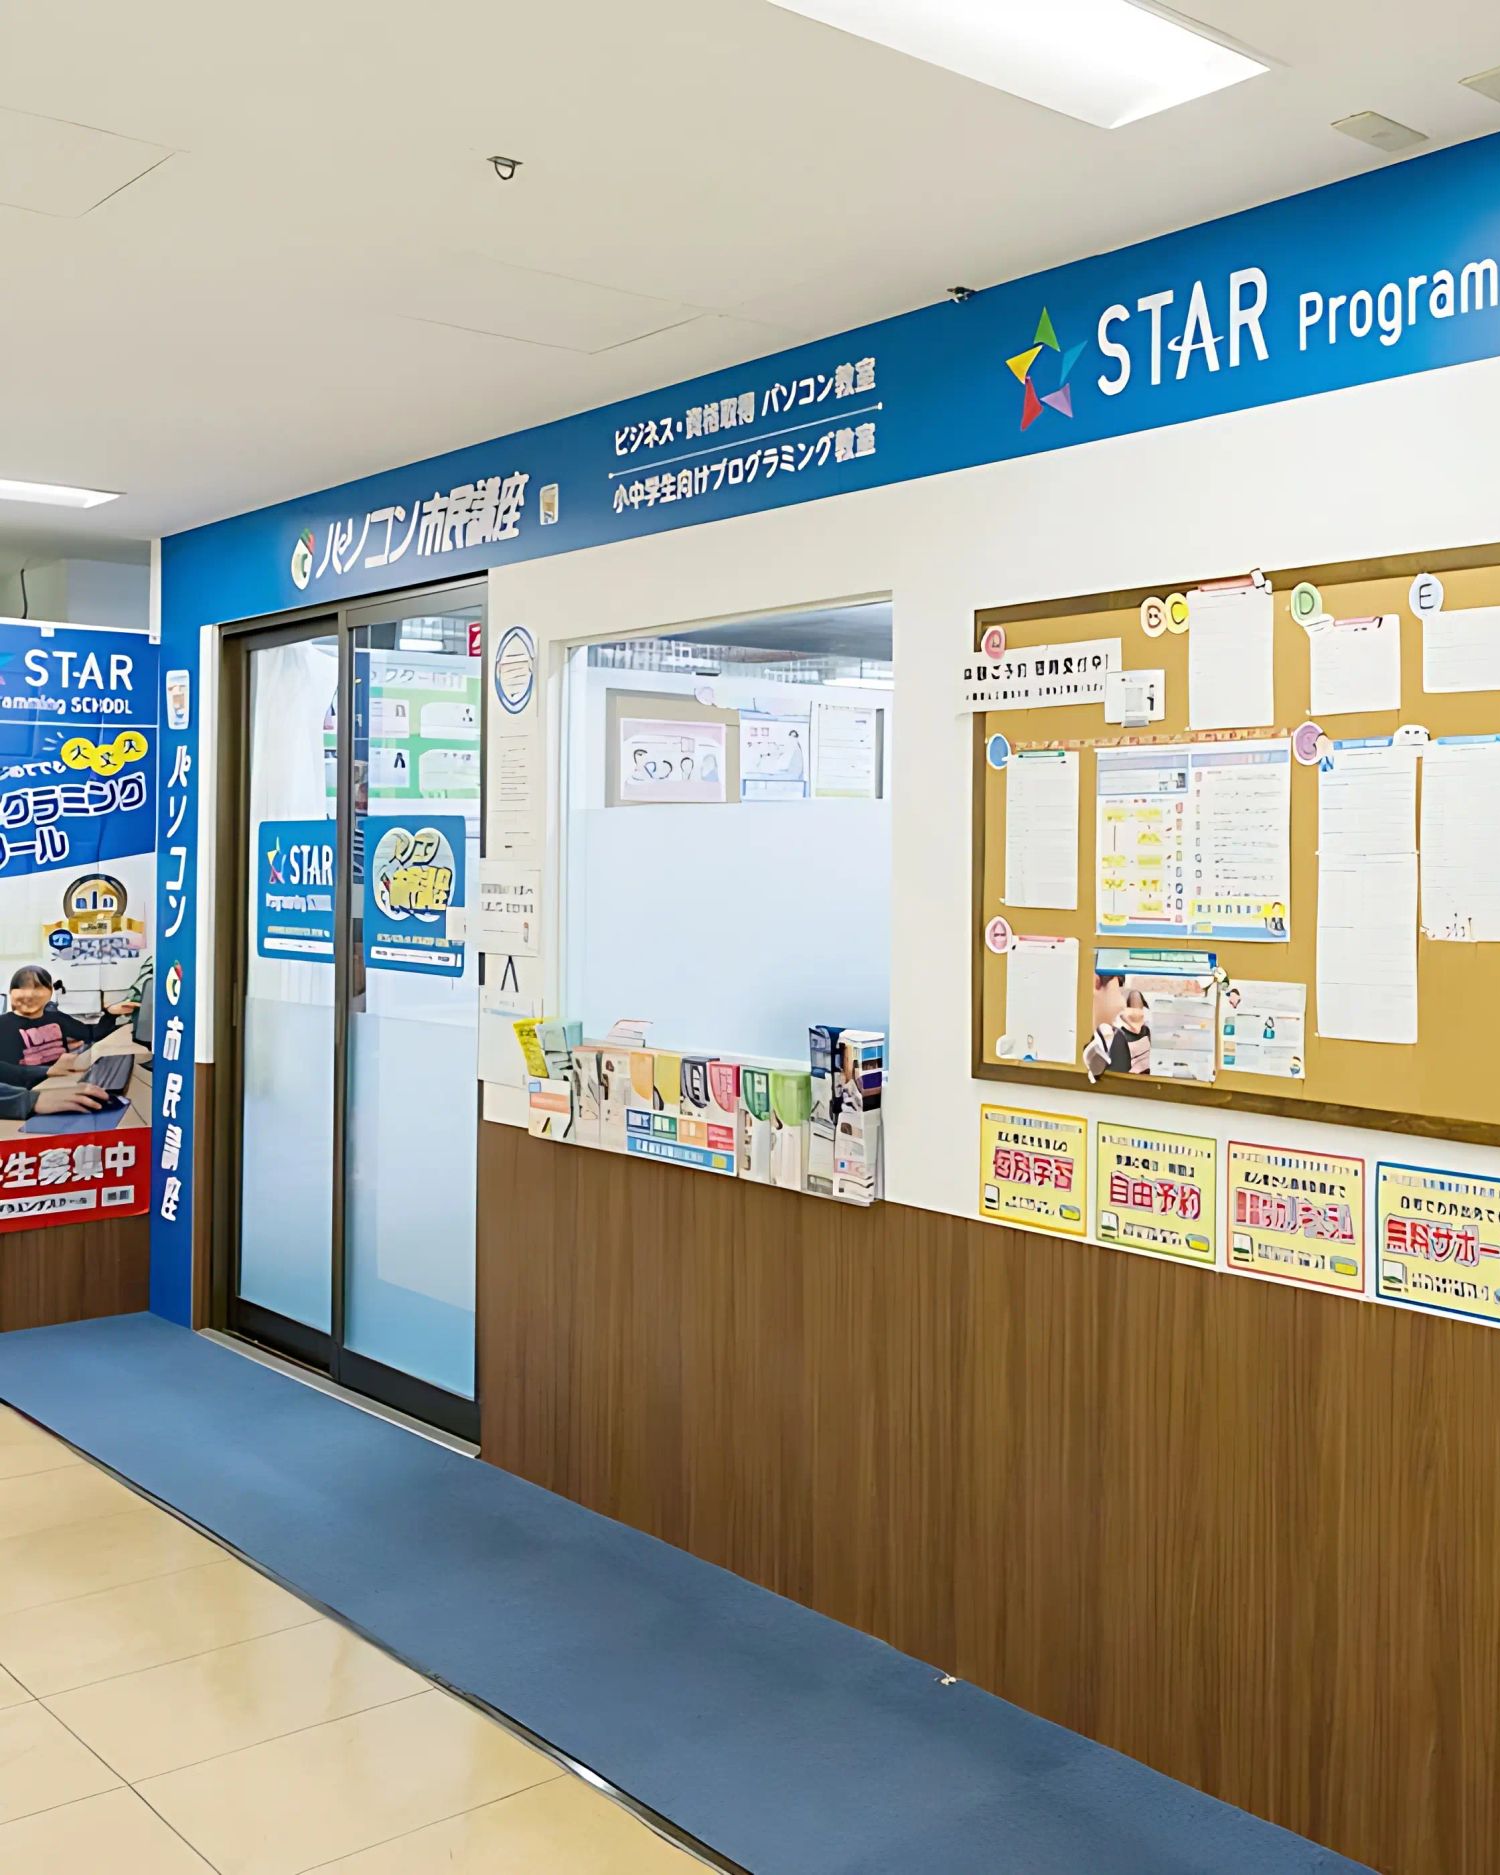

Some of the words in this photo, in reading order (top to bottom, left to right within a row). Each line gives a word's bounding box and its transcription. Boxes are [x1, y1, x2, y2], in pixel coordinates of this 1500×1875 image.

[1097, 266, 1269, 397] STAR
[1419, 583, 1436, 610] E
[24, 649, 133, 691] STAR
[71, 697, 133, 714] SCHOOL
[289, 844, 334, 887] STAR
[0, 1141, 136, 1189] 生募集中
[1110, 1171, 1201, 1221] 自由予約
